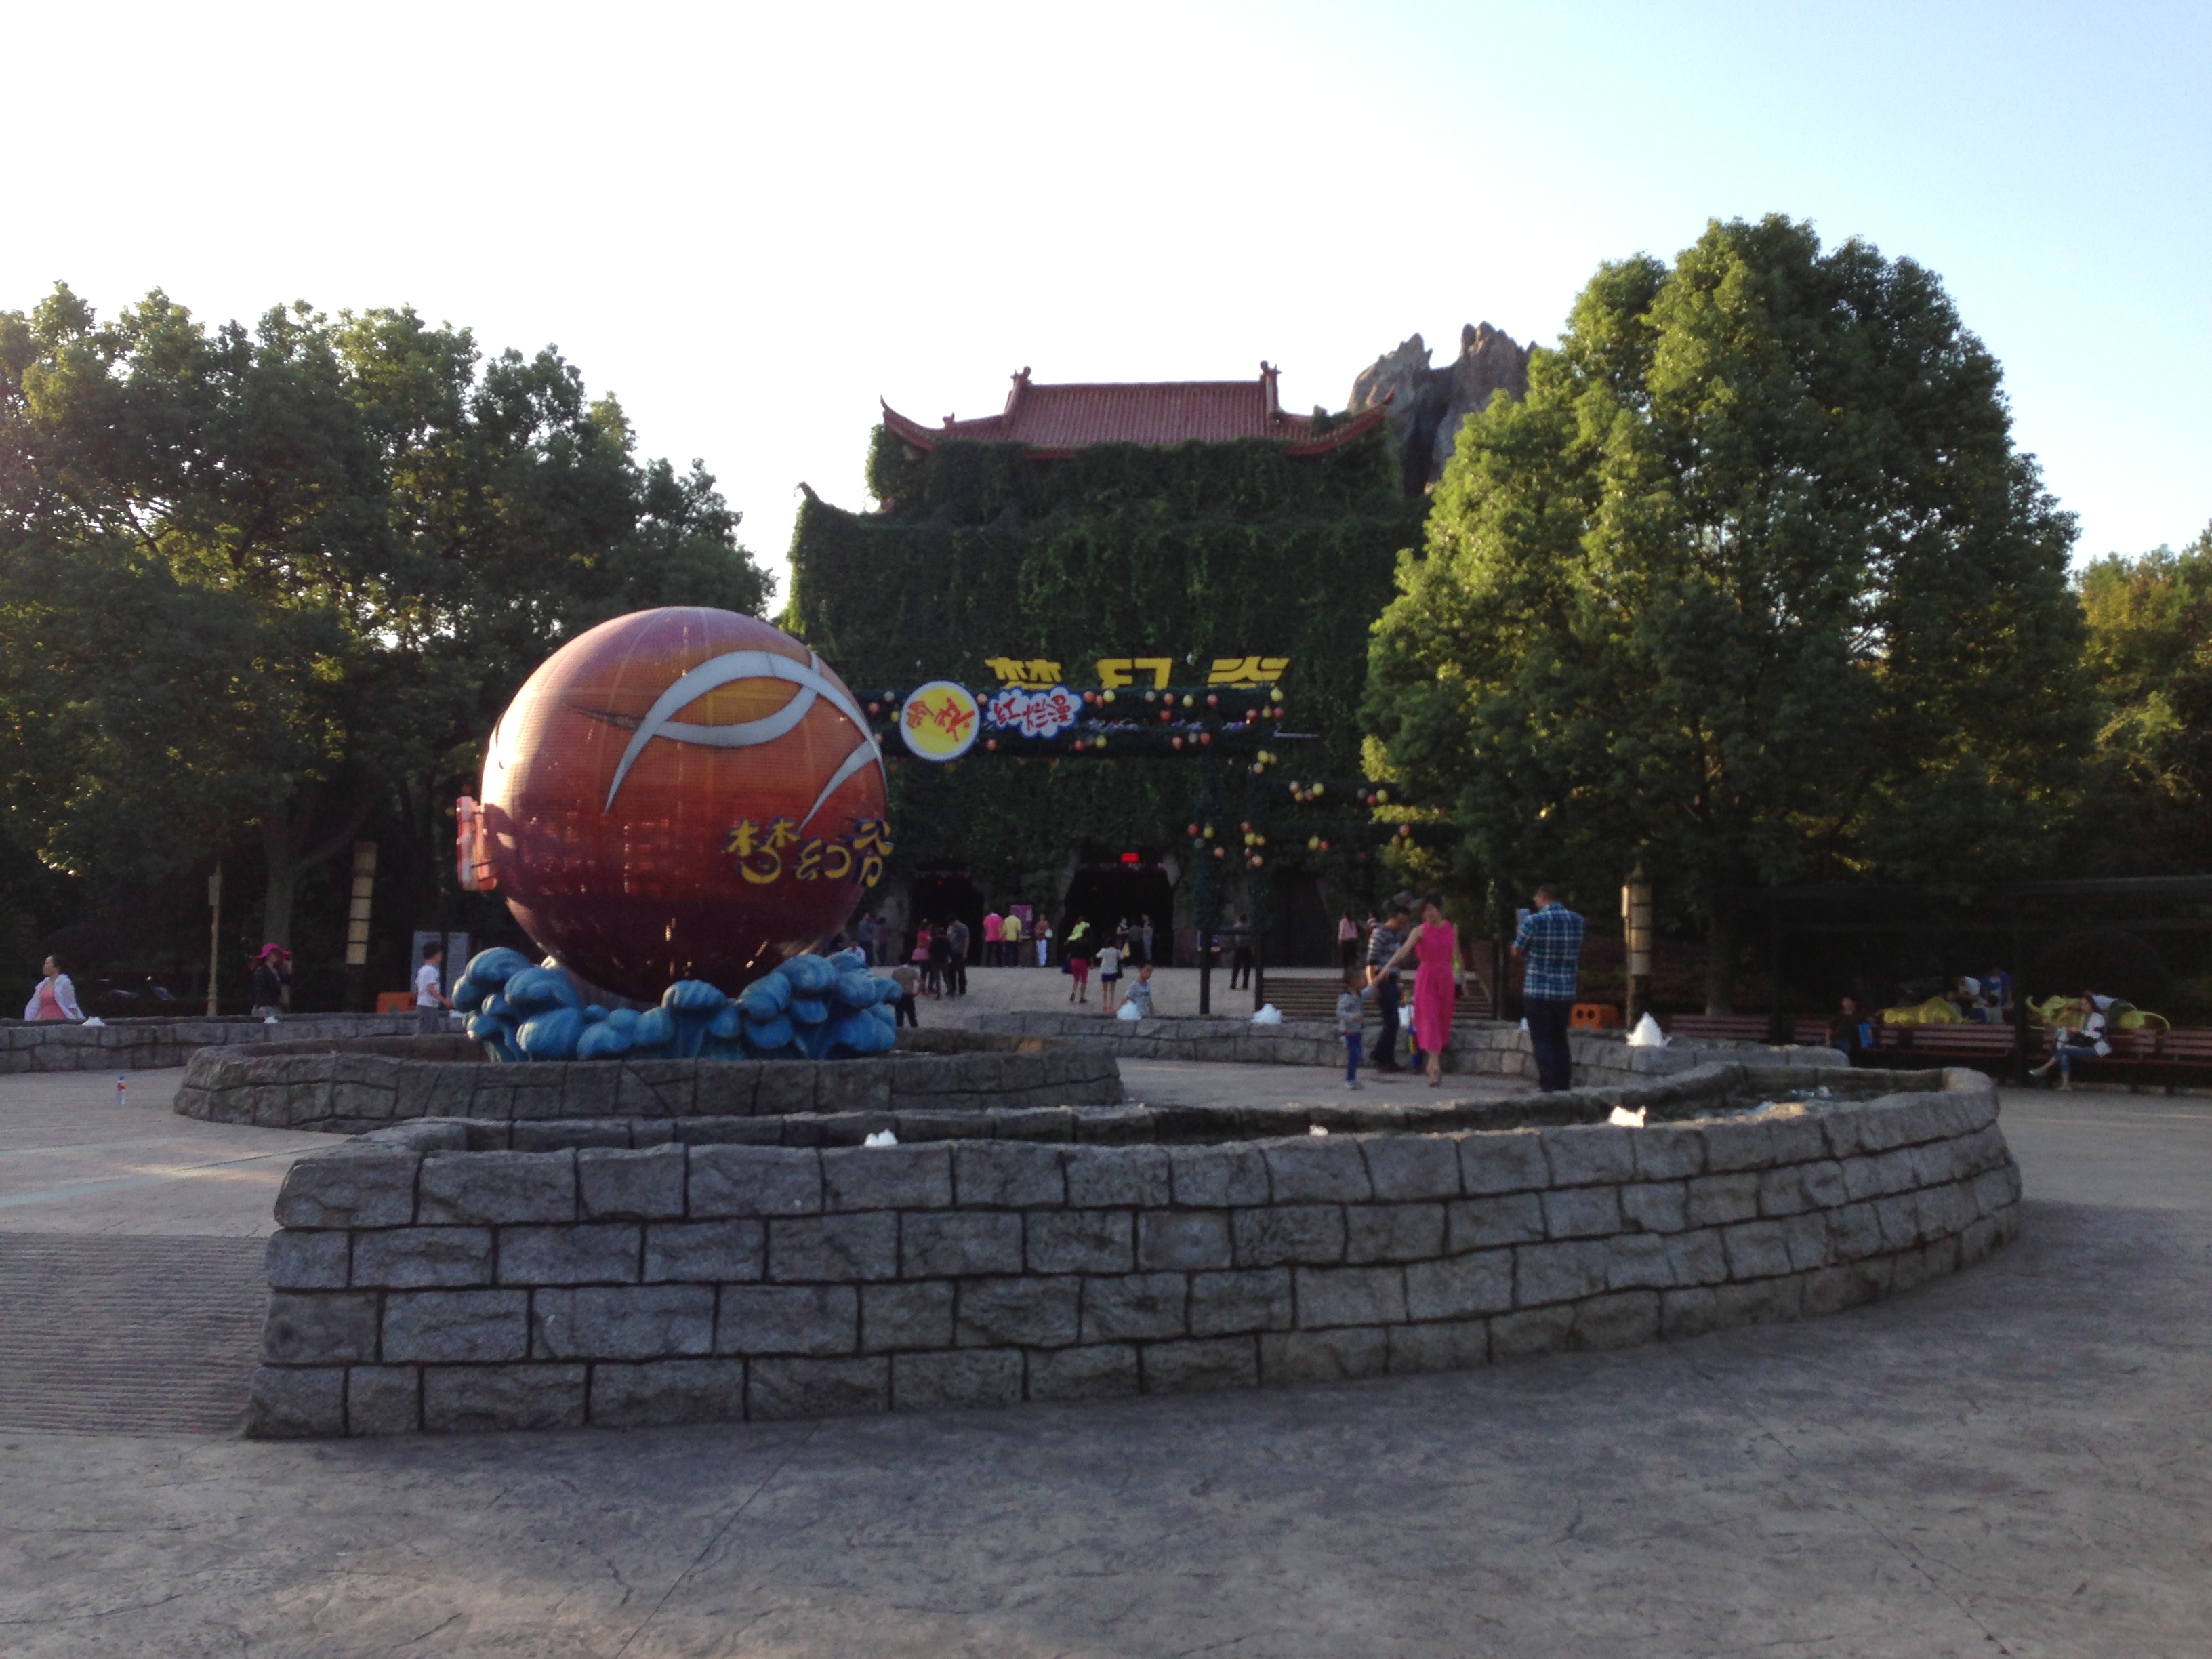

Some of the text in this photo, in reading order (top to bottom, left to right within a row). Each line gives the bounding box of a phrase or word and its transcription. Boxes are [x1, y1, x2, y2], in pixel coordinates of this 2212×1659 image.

[994, 693, 1073, 731] 红烂漫
[726, 817, 895, 888] 梦幻谷
